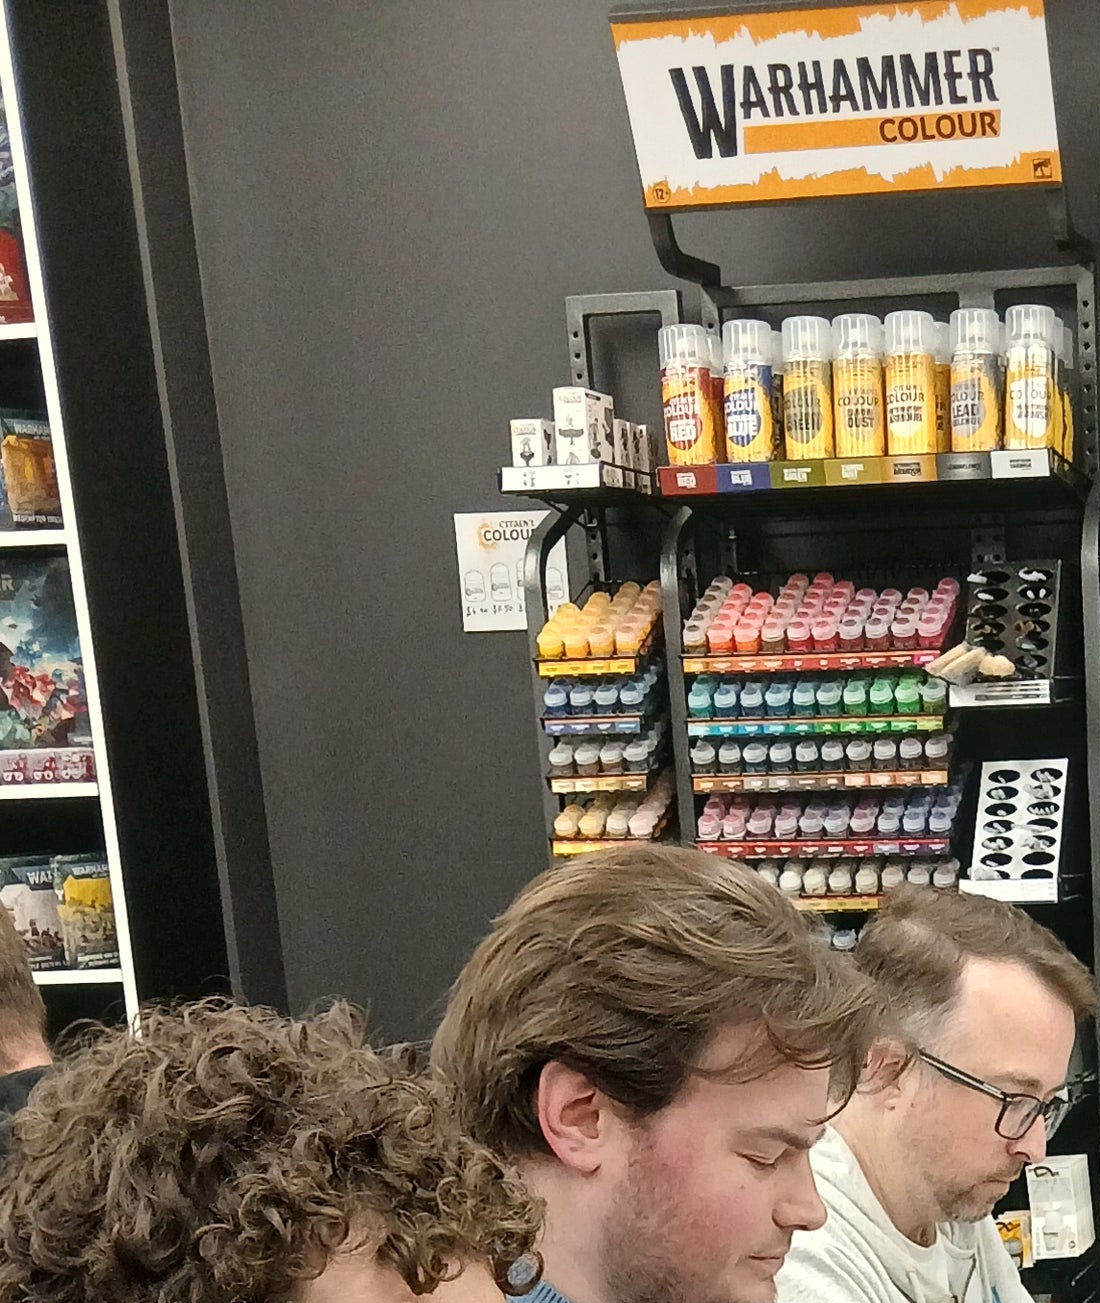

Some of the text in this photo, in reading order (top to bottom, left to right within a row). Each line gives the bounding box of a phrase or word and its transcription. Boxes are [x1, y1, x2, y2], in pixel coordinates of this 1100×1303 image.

[668, 48, 1000, 160] WARHAMMER
[879, 114, 999, 143] COLOUR
[669, 425, 697, 442] RED
[483, 529, 534, 542] COLOU
